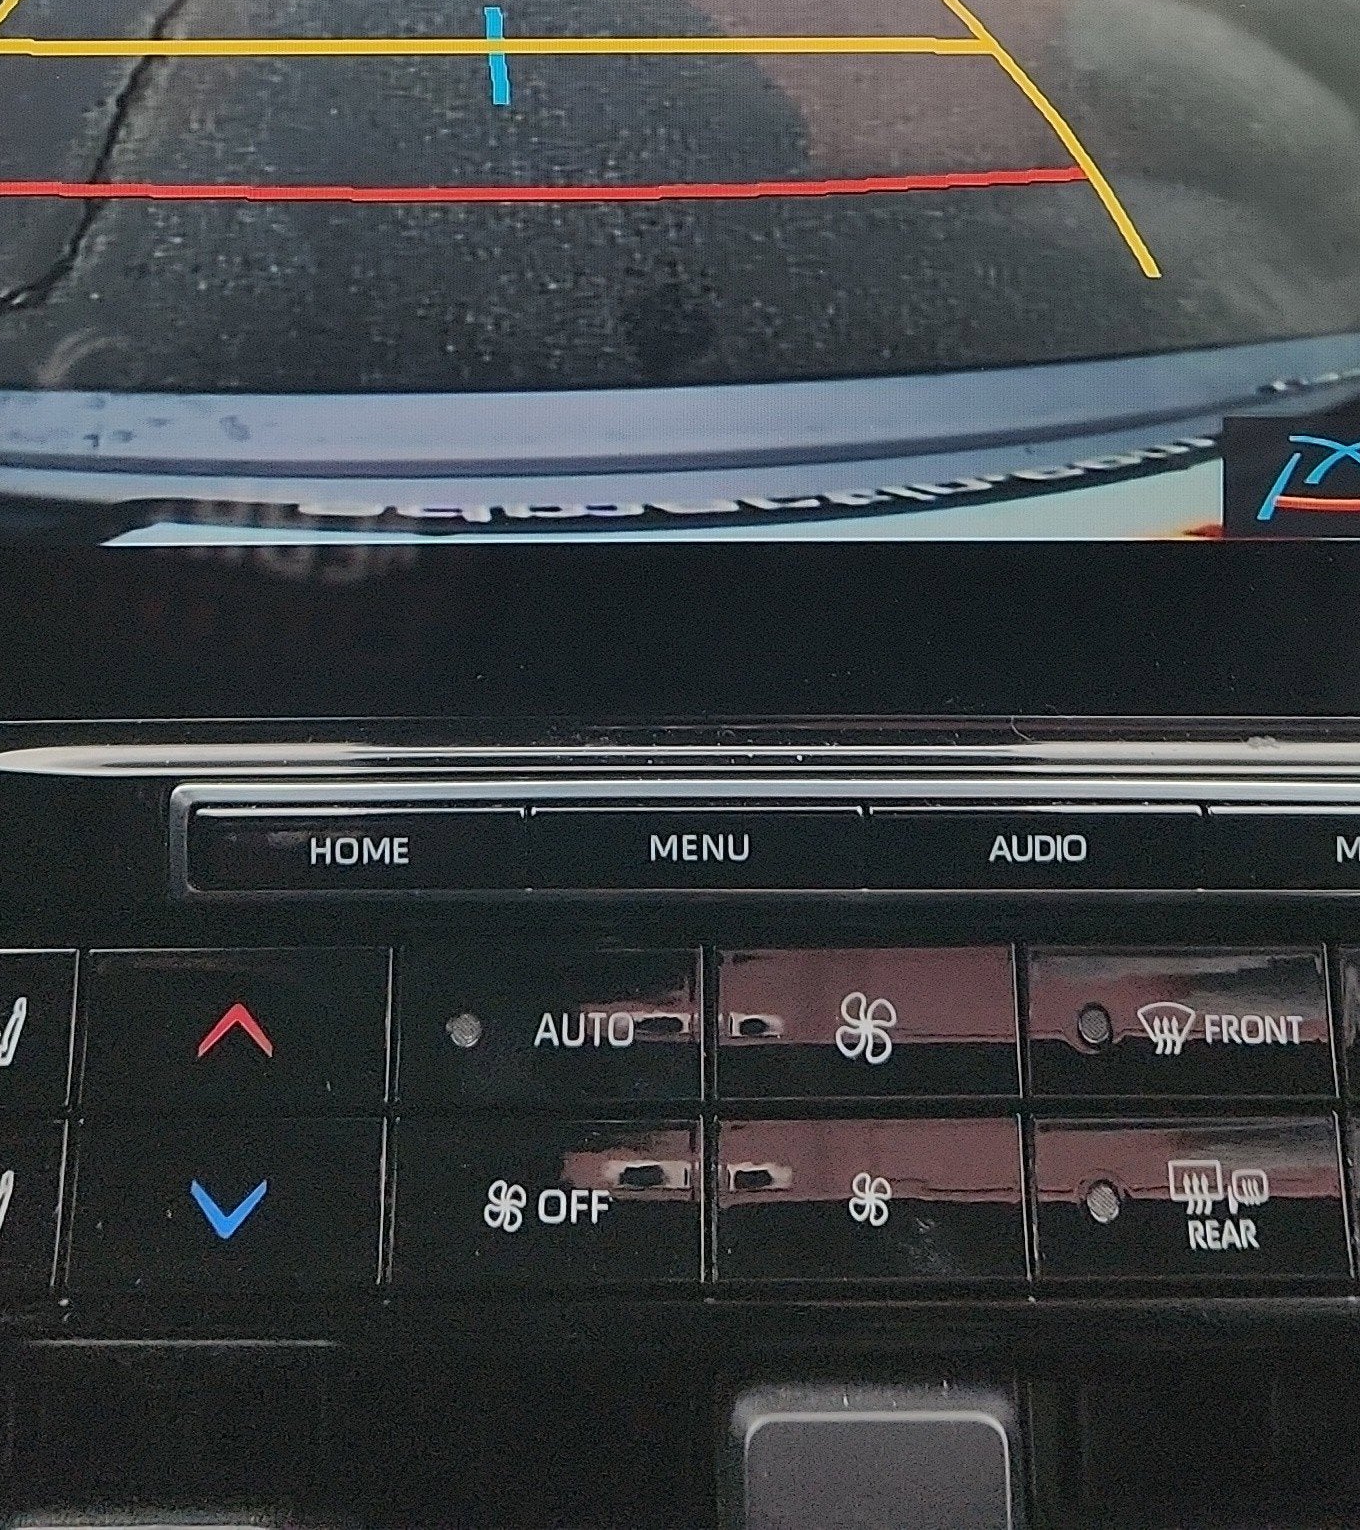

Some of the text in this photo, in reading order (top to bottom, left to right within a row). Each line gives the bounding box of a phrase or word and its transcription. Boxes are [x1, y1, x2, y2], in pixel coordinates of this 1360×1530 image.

[310, 836, 410, 865] HOME
[649, 833, 750, 862] MENU
[988, 834, 1088, 863] AUDIO
[533, 1012, 636, 1048] AUTO
[1204, 1014, 1303, 1045] FRONT
[538, 1189, 611, 1224] OFF
[1188, 1219, 1260, 1250] REAR
